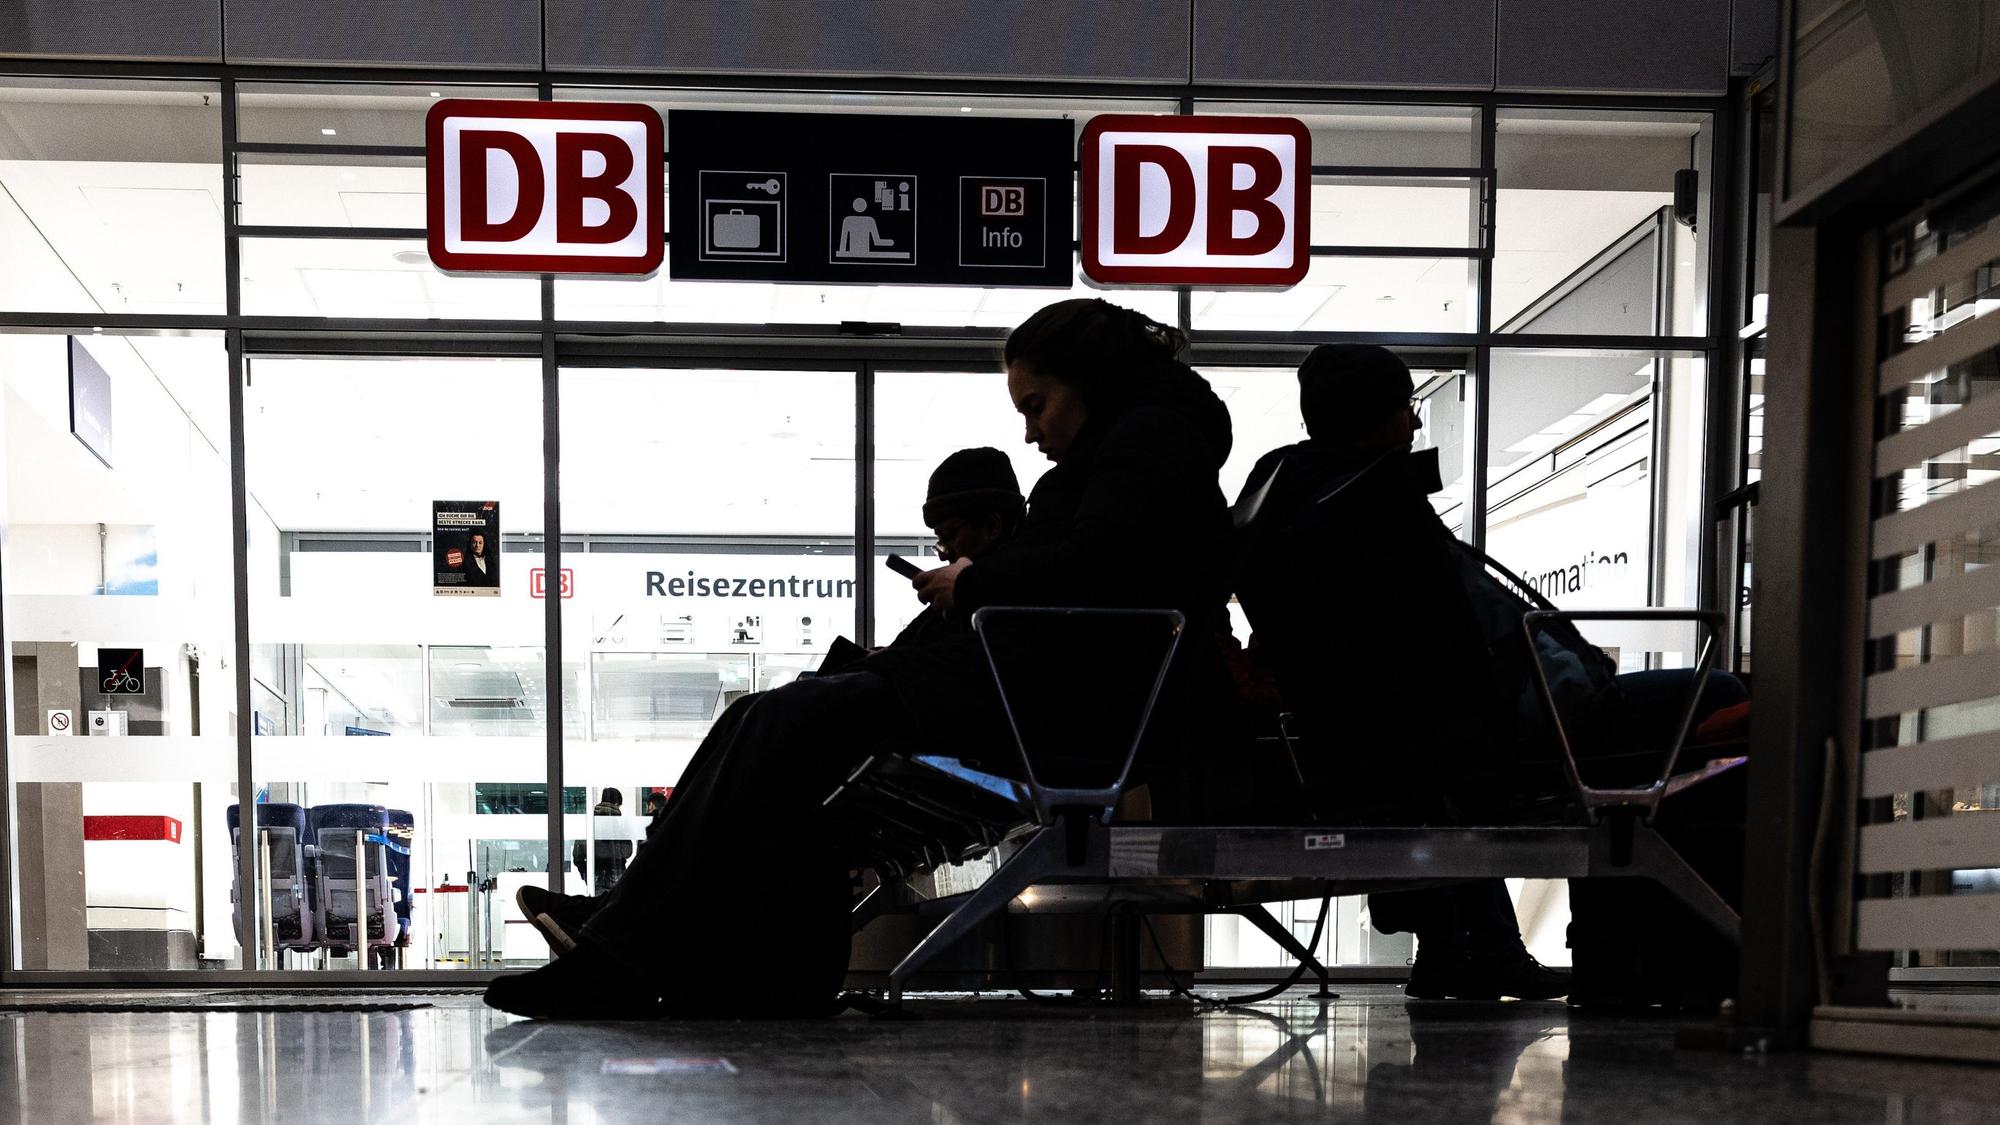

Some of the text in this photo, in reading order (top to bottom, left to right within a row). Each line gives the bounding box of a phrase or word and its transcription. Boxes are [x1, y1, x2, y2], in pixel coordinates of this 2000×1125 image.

[459, 129, 638, 244] DB
[1113, 144, 1286, 256] DB
[985, 188, 1023, 214] DB
[982, 226, 1023, 248] Info
[646, 570, 856, 598] Reisezentrum
